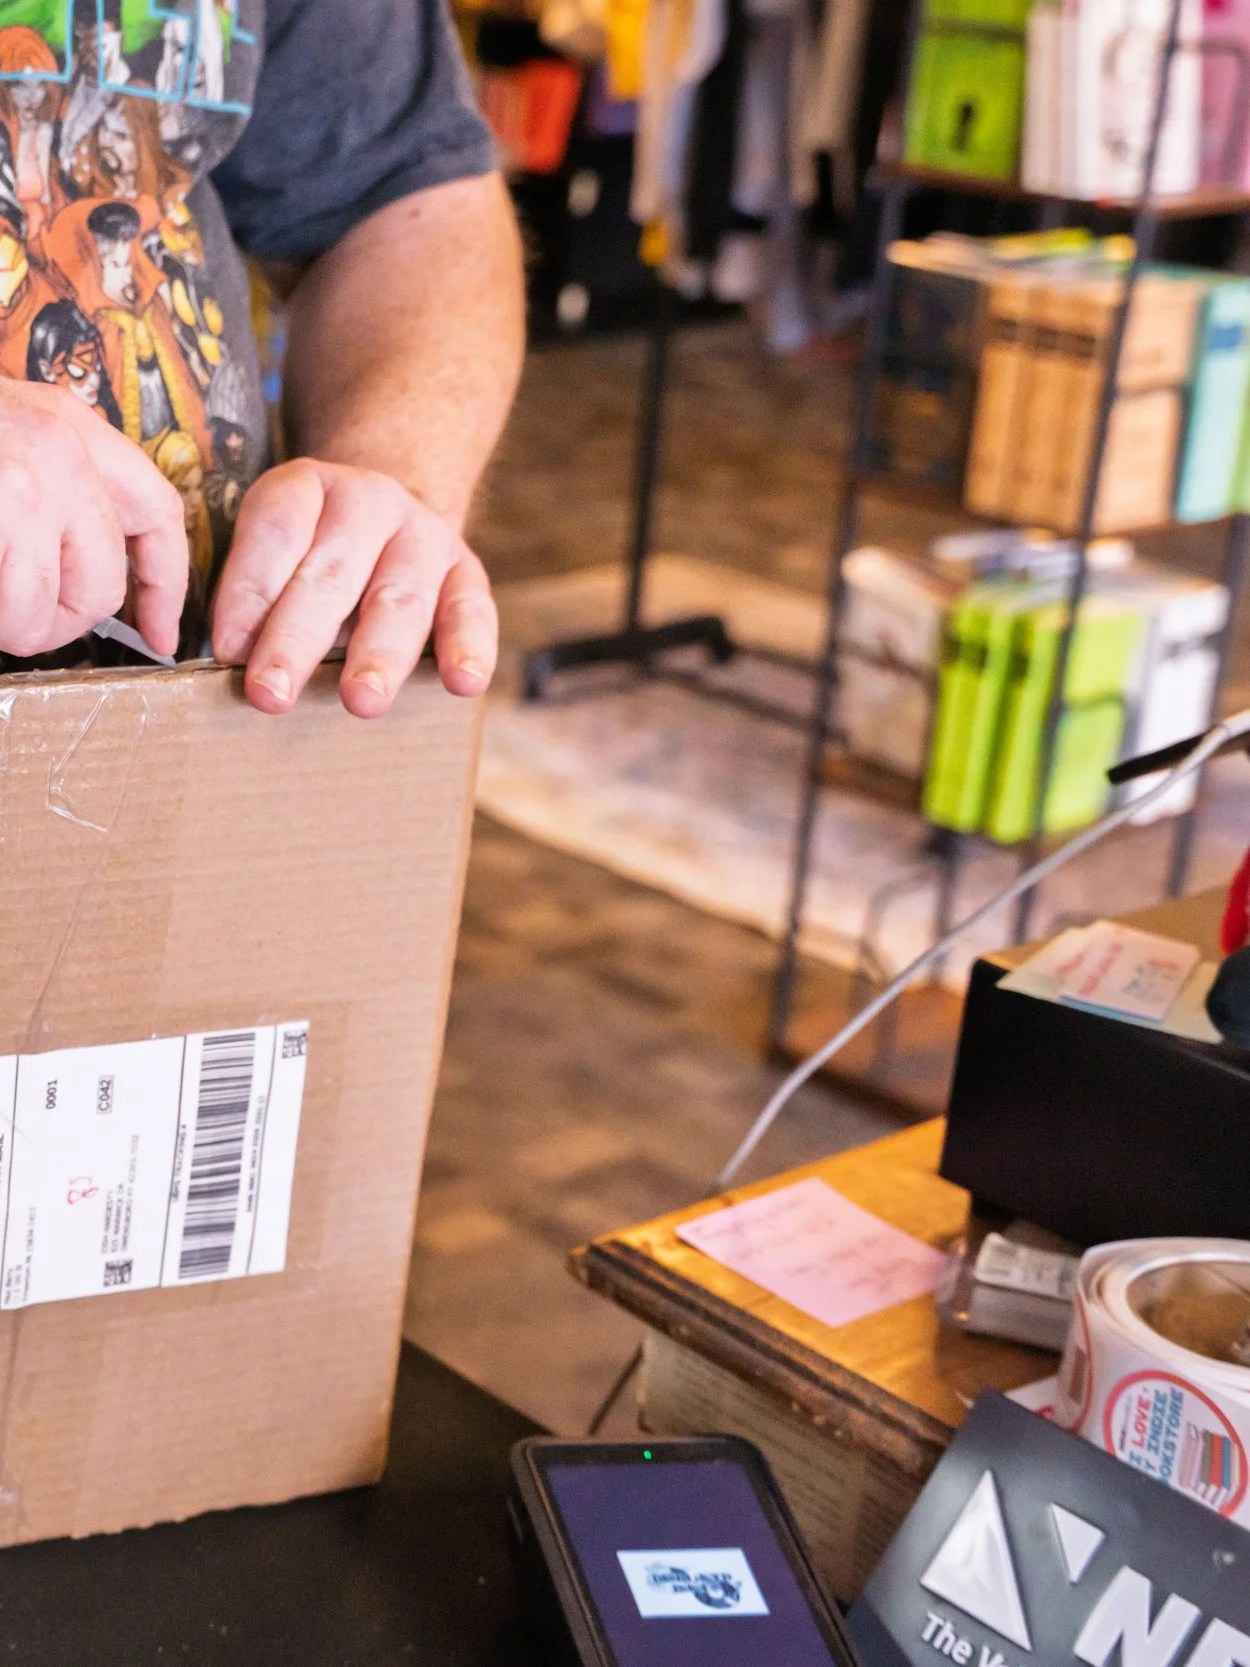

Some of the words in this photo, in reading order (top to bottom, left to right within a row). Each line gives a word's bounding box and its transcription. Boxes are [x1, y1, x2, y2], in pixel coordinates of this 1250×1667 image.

[45, 1079, 57, 1109] 0001
[97, 1078, 111, 1112] C042
[1132, 1395, 1151, 1448] LOVE
[1147, 1389, 1167, 1456] INDIE
[920, 1612, 970, 1666] The
